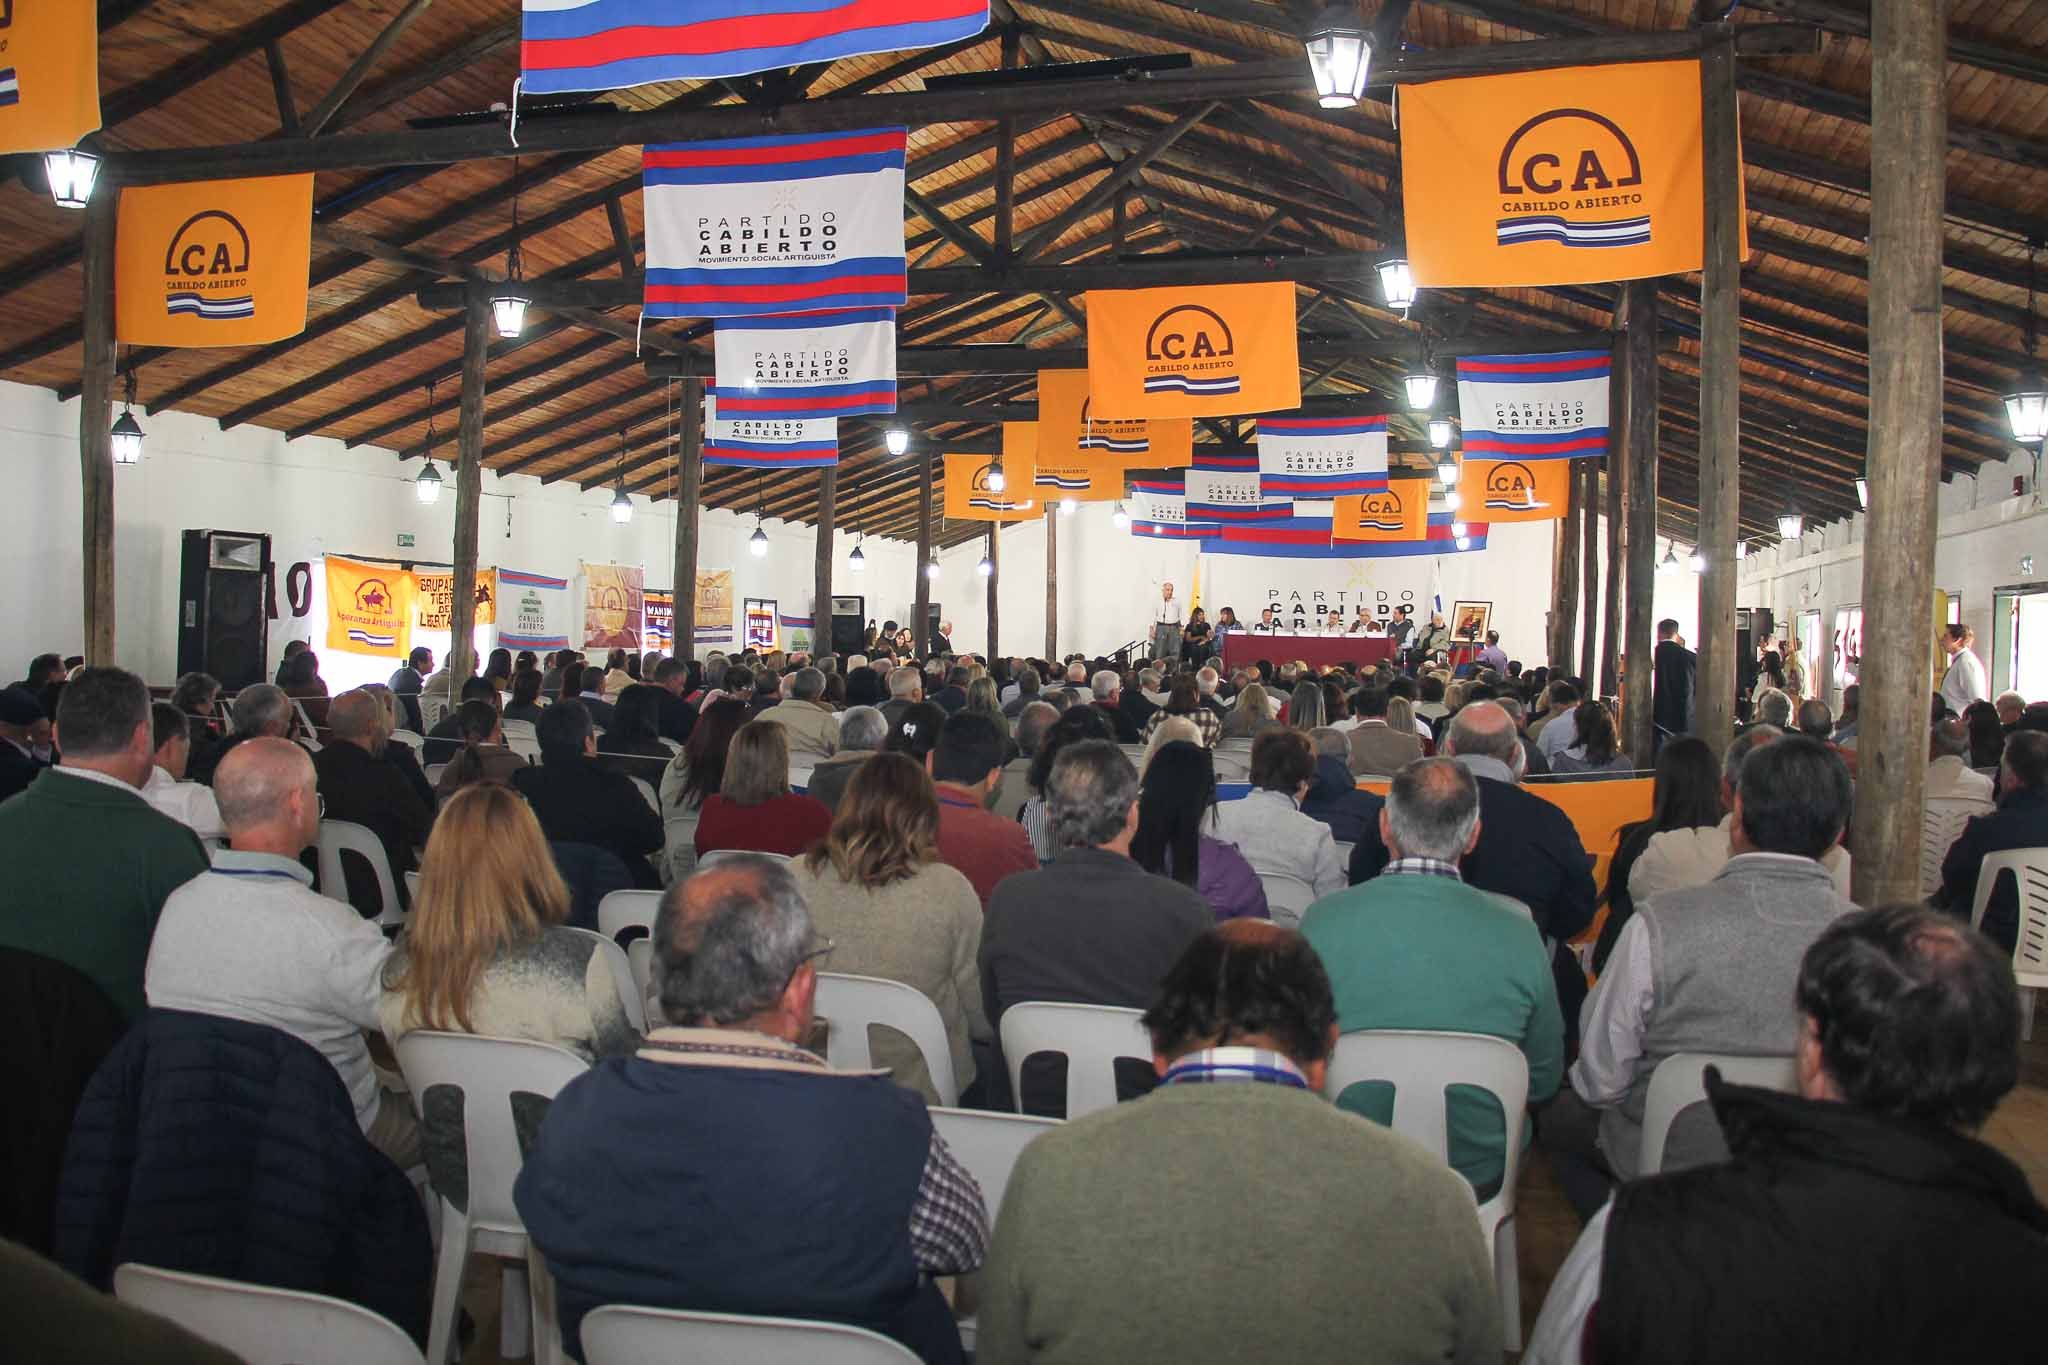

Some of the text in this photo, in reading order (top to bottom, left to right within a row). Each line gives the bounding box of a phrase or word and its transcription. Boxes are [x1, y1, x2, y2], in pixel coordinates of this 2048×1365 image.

[1522, 150, 1613, 194] CA
[1502, 194, 1642, 212] CABILDO ABIERTO
[698, 212, 836, 228] PARTIDO
[699, 226, 837, 241] CABILDO
[699, 240, 837, 255] ABIERTO
[181, 243, 232, 276] CA
[784, 253, 836, 261] ARTIGUISTA
[167, 279, 247, 290] CABILDO ABIERTO
[1161, 331, 1217, 360] CA
[755, 349, 848, 359] PARTIDO
[755, 358, 848, 368] CABILDO
[1148, 361, 1234, 373] CABILDO ABIERTO
[755, 367, 848, 378] ABIERTO
[1495, 401, 1583, 409] PARTIDO
[1496, 408, 1584, 417] CABILDO
[733, 421, 803, 429] CABILDO
[1497, 417, 1584, 425] ABIERTO
[732, 428, 802, 436] ABIERTO
[1286, 455, 1354, 463] CABILDO
[1286, 461, 1354, 470] ABIERTO
[1495, 476, 1525, 491] CA
[1368, 501, 1393, 513] CA
[1268, 589, 1414, 601] PARTIDO
